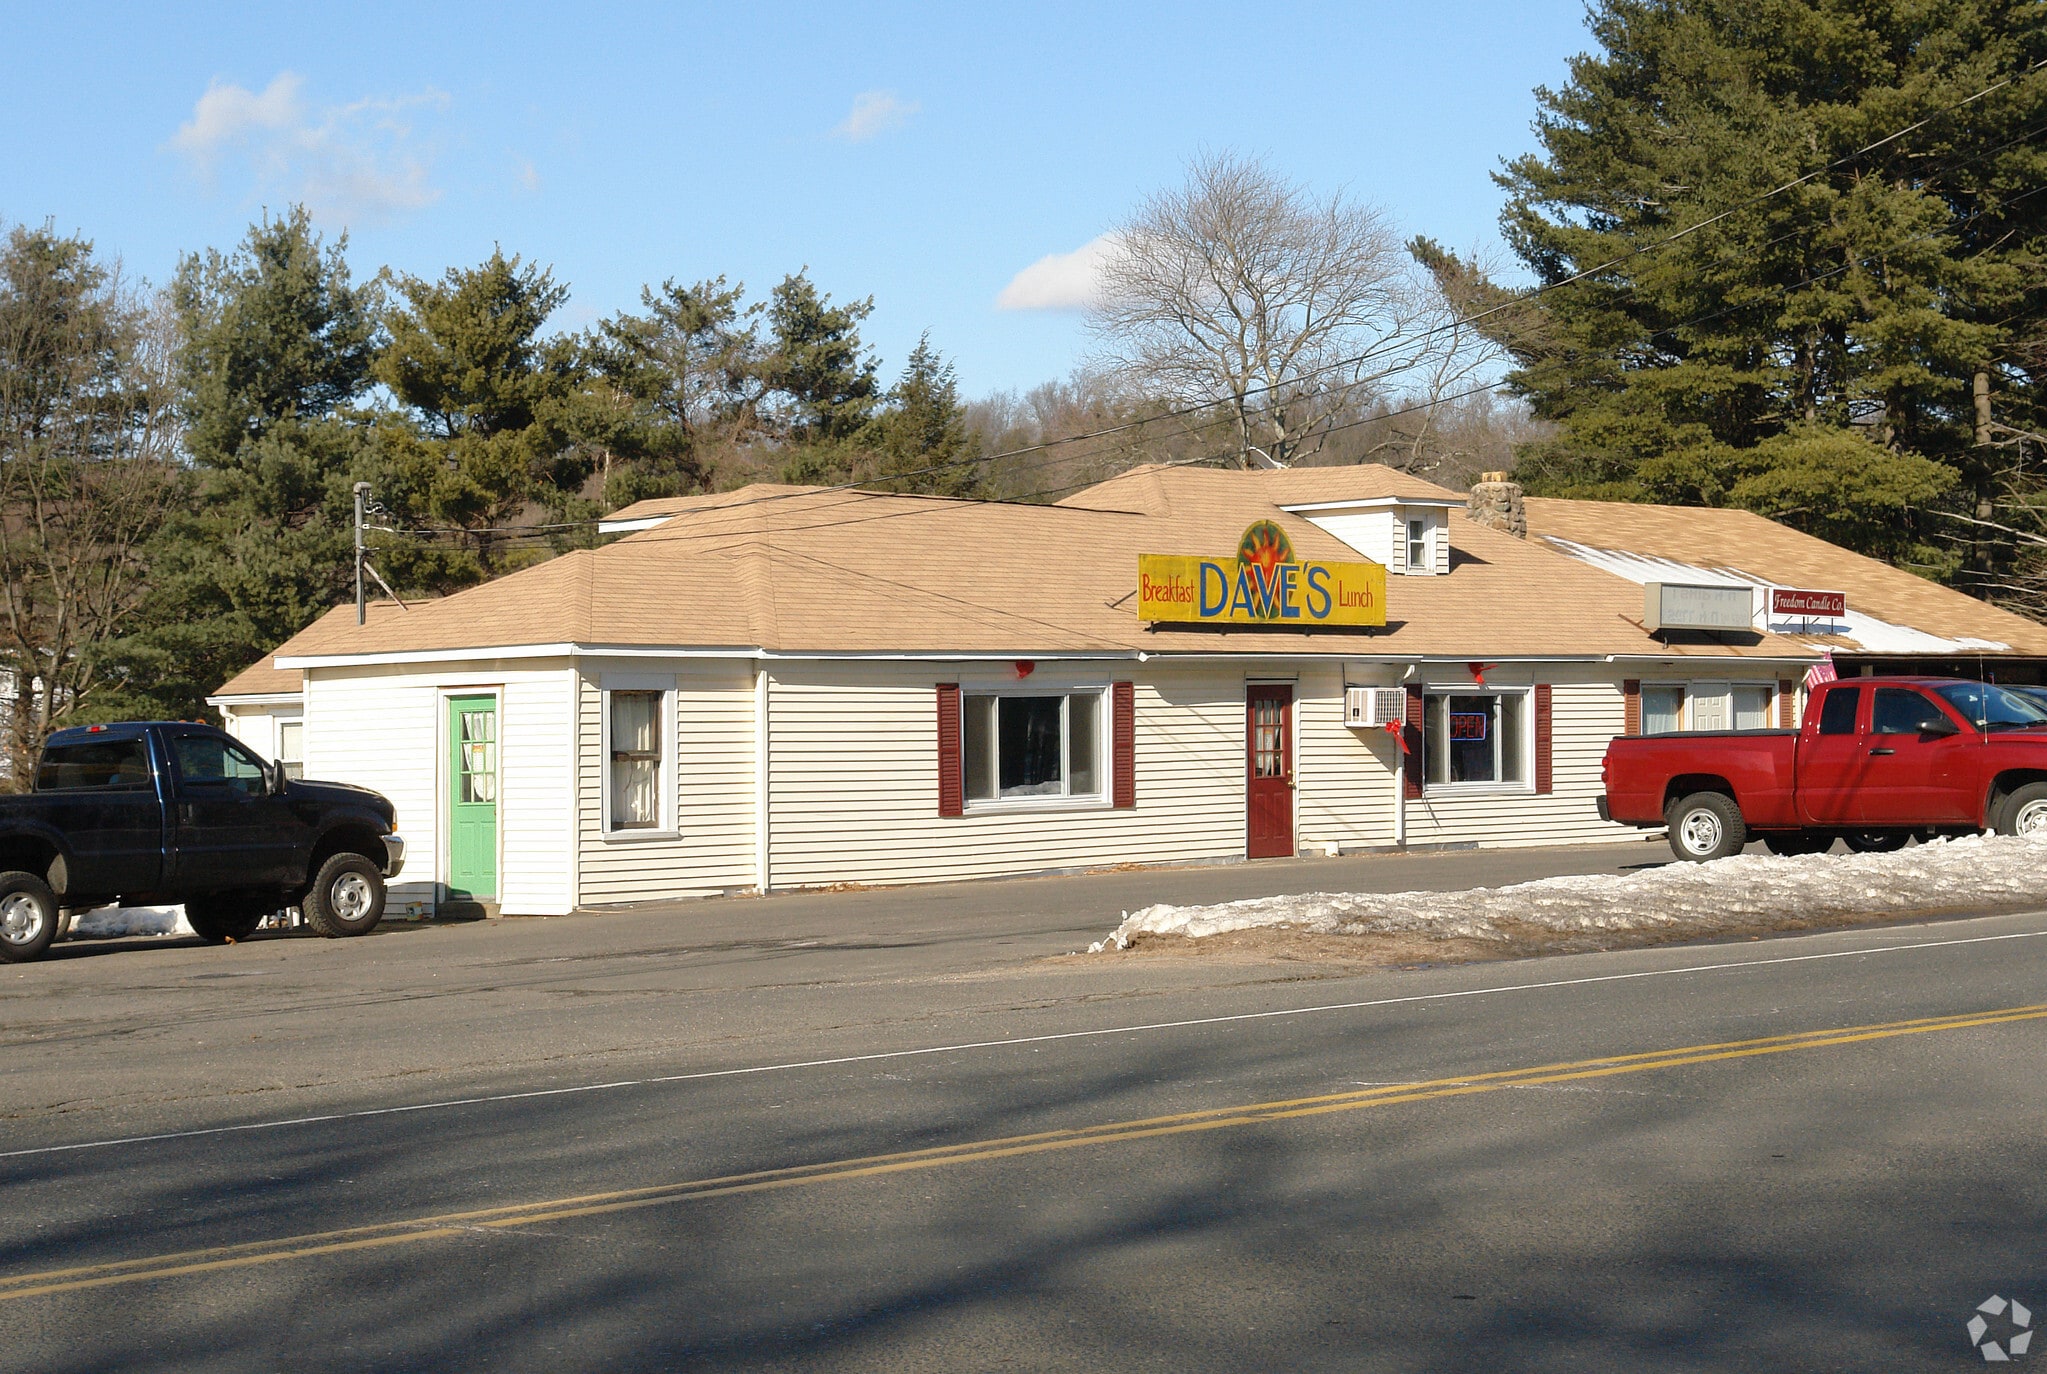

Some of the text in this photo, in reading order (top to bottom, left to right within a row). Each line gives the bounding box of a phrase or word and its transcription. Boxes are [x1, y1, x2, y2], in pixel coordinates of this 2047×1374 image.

[1142, 561, 1374, 619] Breakfast DAVE'S Lunch
[1774, 593, 1844, 612] Freedom Candle Co.
[1450, 715, 1484, 738] OPEN
